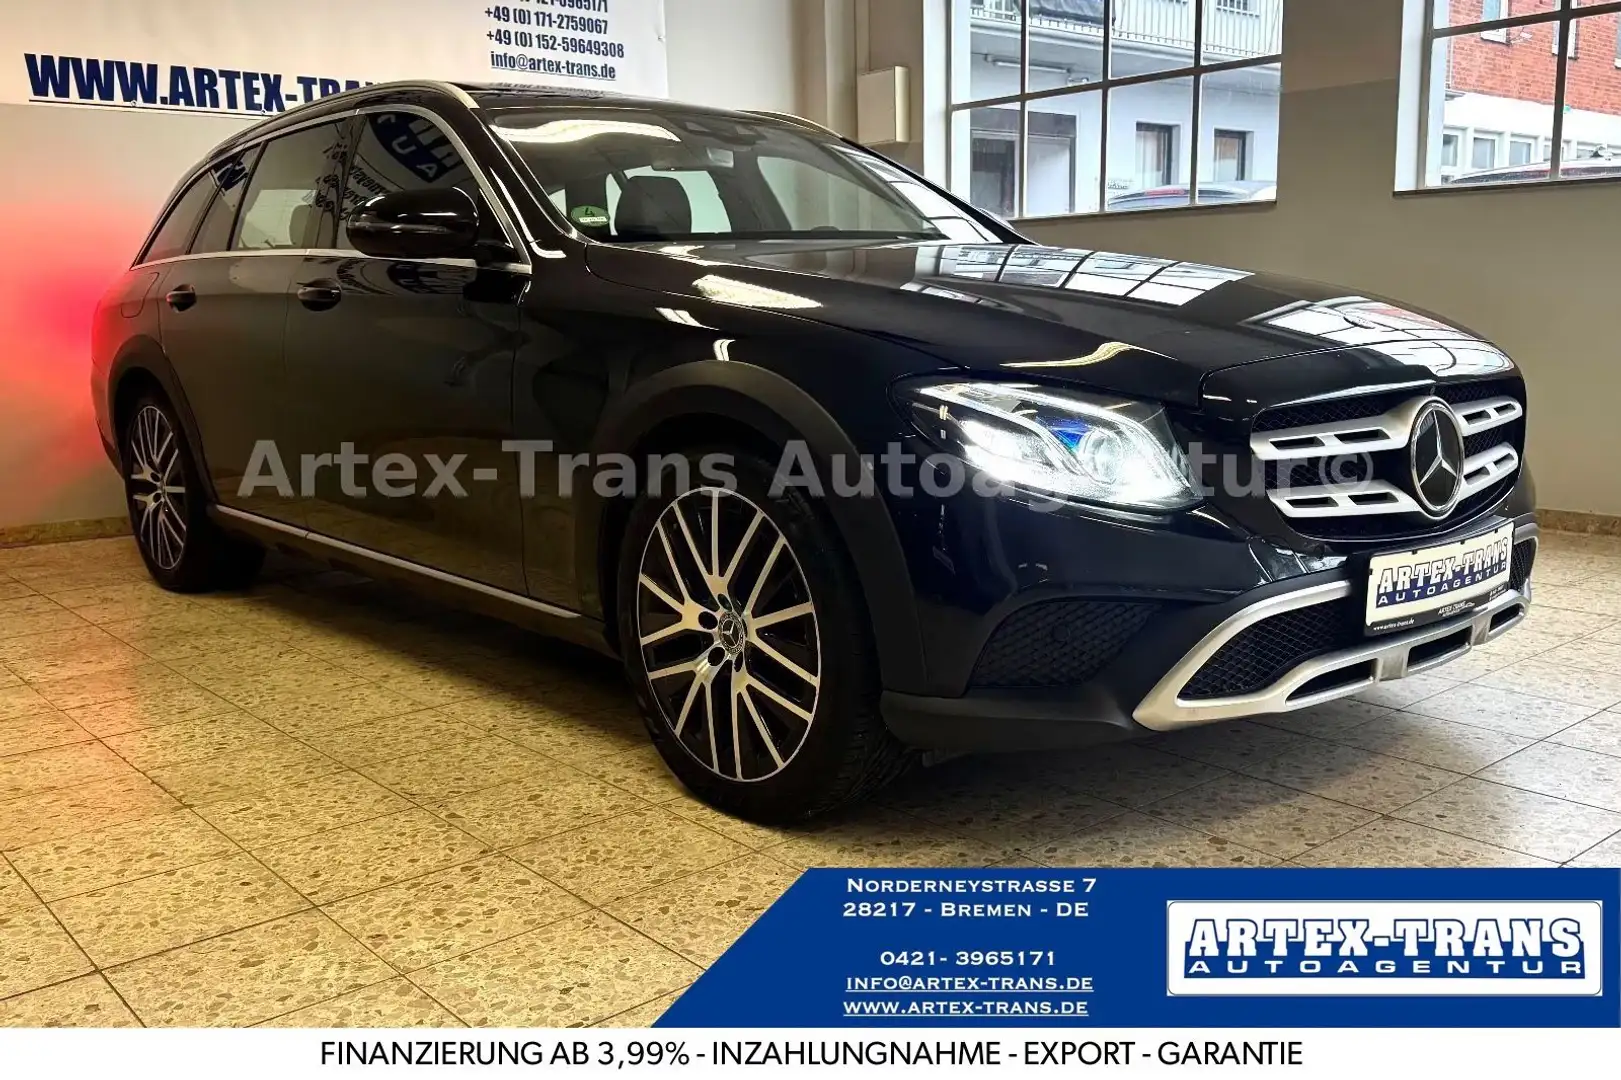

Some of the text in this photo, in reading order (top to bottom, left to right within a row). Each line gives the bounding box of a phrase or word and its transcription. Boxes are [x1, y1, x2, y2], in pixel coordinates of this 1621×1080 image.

[485, 6, 608, 35] +49 (0) 171-2759067
[537, 0, 608, 13] -965171
[487, 29, 625, 58] +49 (0) 152-59649308
[491, 51, 616, 80] info@artex-trans.de
[24, 53, 374, 113] WWW.ARTEX-TR
[1378, 536, 1509, 595] ARTEX-TRANS
[1377, 561, 1508, 606] AUTOAGENTUR
